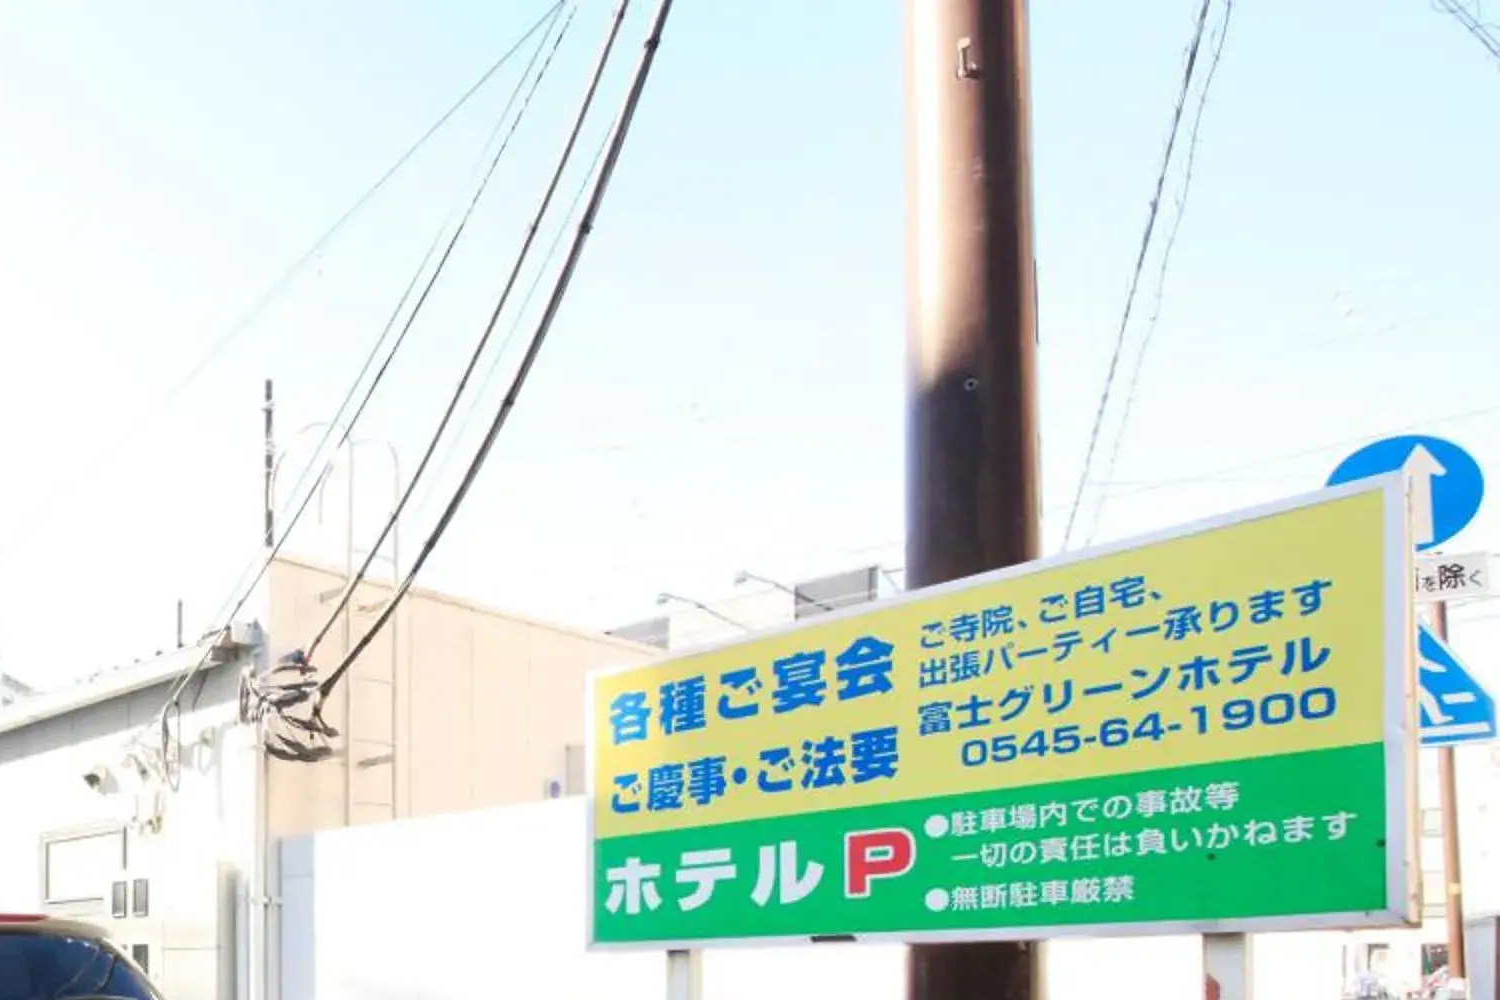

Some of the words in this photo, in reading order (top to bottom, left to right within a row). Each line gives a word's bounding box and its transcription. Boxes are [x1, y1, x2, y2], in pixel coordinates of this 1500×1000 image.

[920, 575, 1162, 648] ご寺院、ご自宅、
[1415, 563, 1483, 592] を除く
[920, 580, 1333, 688] 出張パーティー承ります
[610, 635, 895, 745] 各種ご宴会
[918, 637, 1331, 736] 富士グリーンホテル
[961, 686, 1336, 766] 0545-64-1900
[611, 726, 898, 813] ご慶事・ご法要
[950, 781, 1240, 837] 駐車場内での事故等
[605, 840, 825, 915] ホテル
[844, 827, 918, 899] P
[951, 811, 1358, 867] 一切の責任は負いかねます
[950, 875, 1136, 911] 無断駐車厳禁
